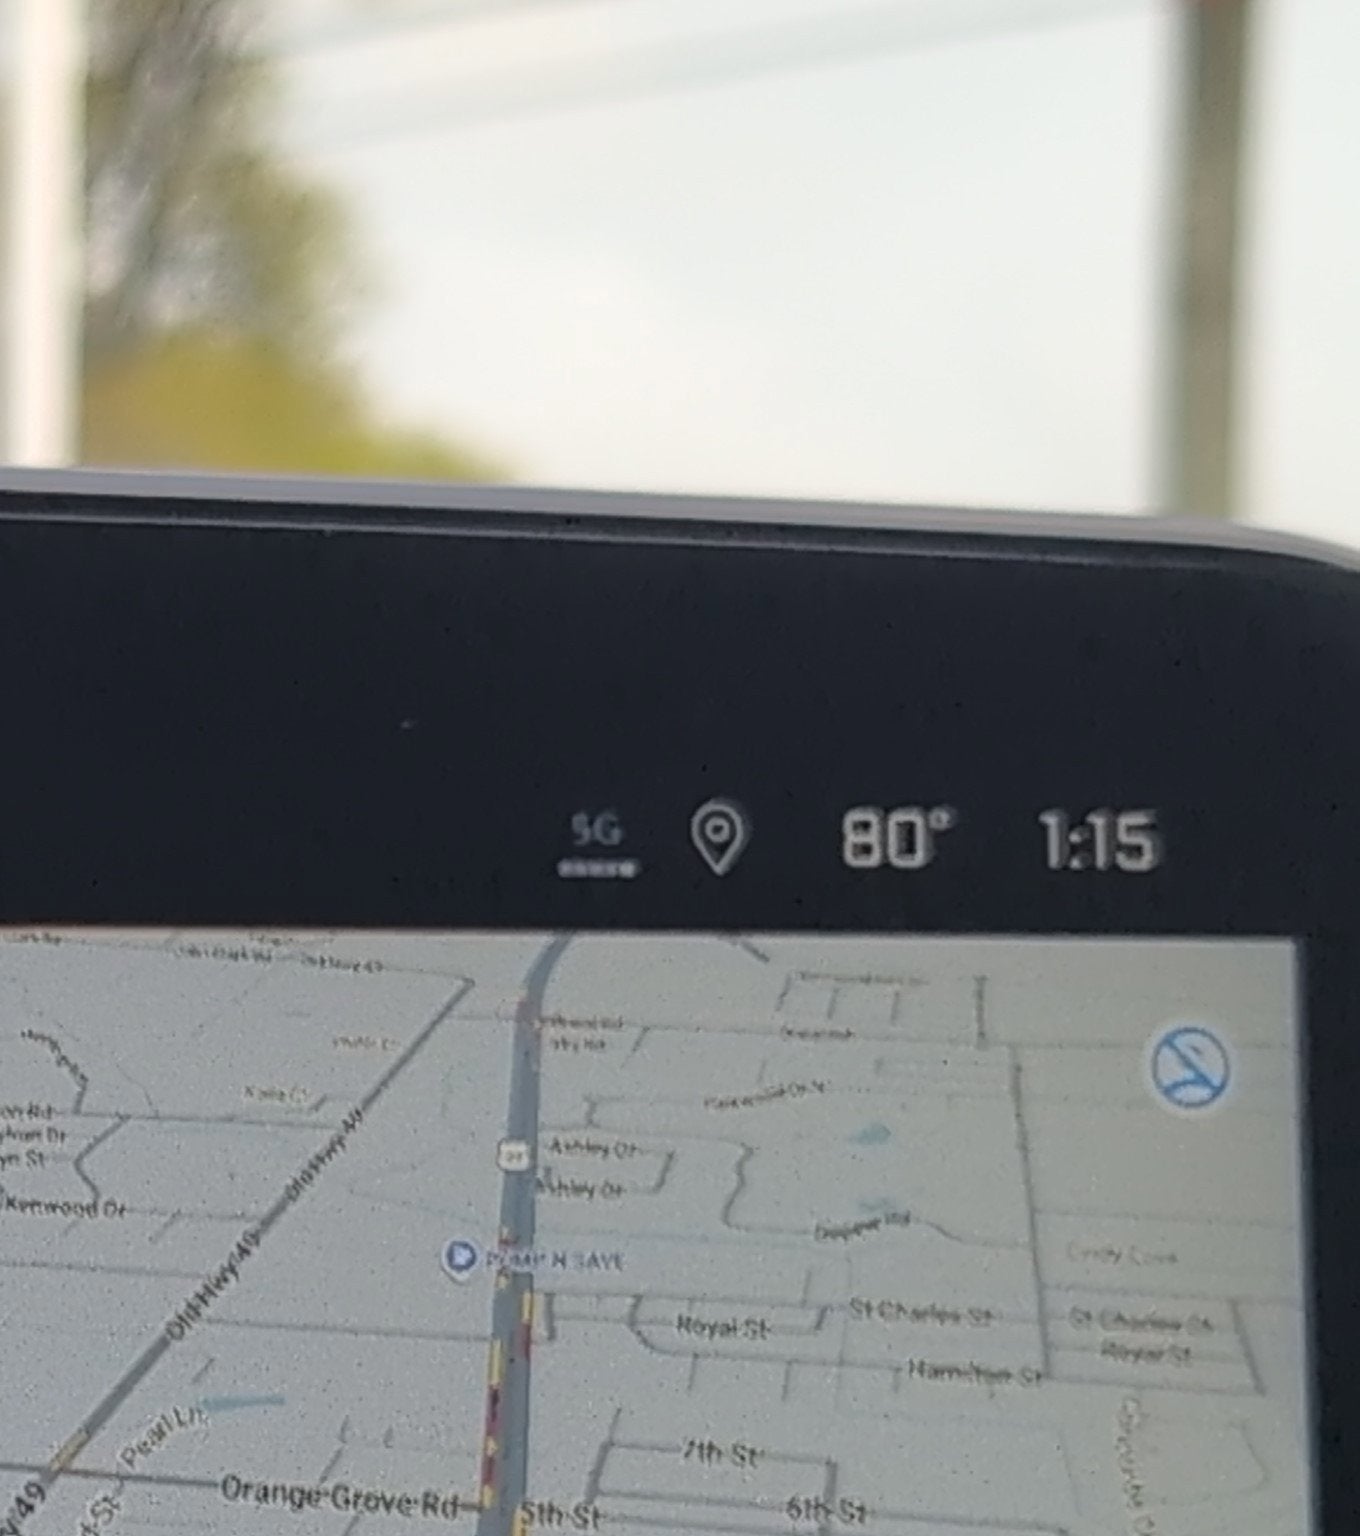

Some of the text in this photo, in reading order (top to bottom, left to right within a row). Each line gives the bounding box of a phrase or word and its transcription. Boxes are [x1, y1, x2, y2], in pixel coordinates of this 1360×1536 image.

[571, 811, 623, 846] 5G
[842, 804, 957, 868] 80°
[1037, 808, 1160, 872] 1:15
[25, 1150, 47, 1169] St
[166, 1226, 262, 1342] Old Hwy 49
[677, 1313, 772, 1341] Royal St
[850, 1299, 994, 1328] St Charles St
[119, 1412, 177, 1471] Pearl
[683, 1437, 762, 1469] 7th St
[13, 1481, 48, 1518] 49
[89, 1495, 122, 1530] St
[220, 1473, 462, 1521] Orange Grove Rd
[785, 1496, 870, 1524] 6th St
[521, 1499, 603, 1532] 5th St
